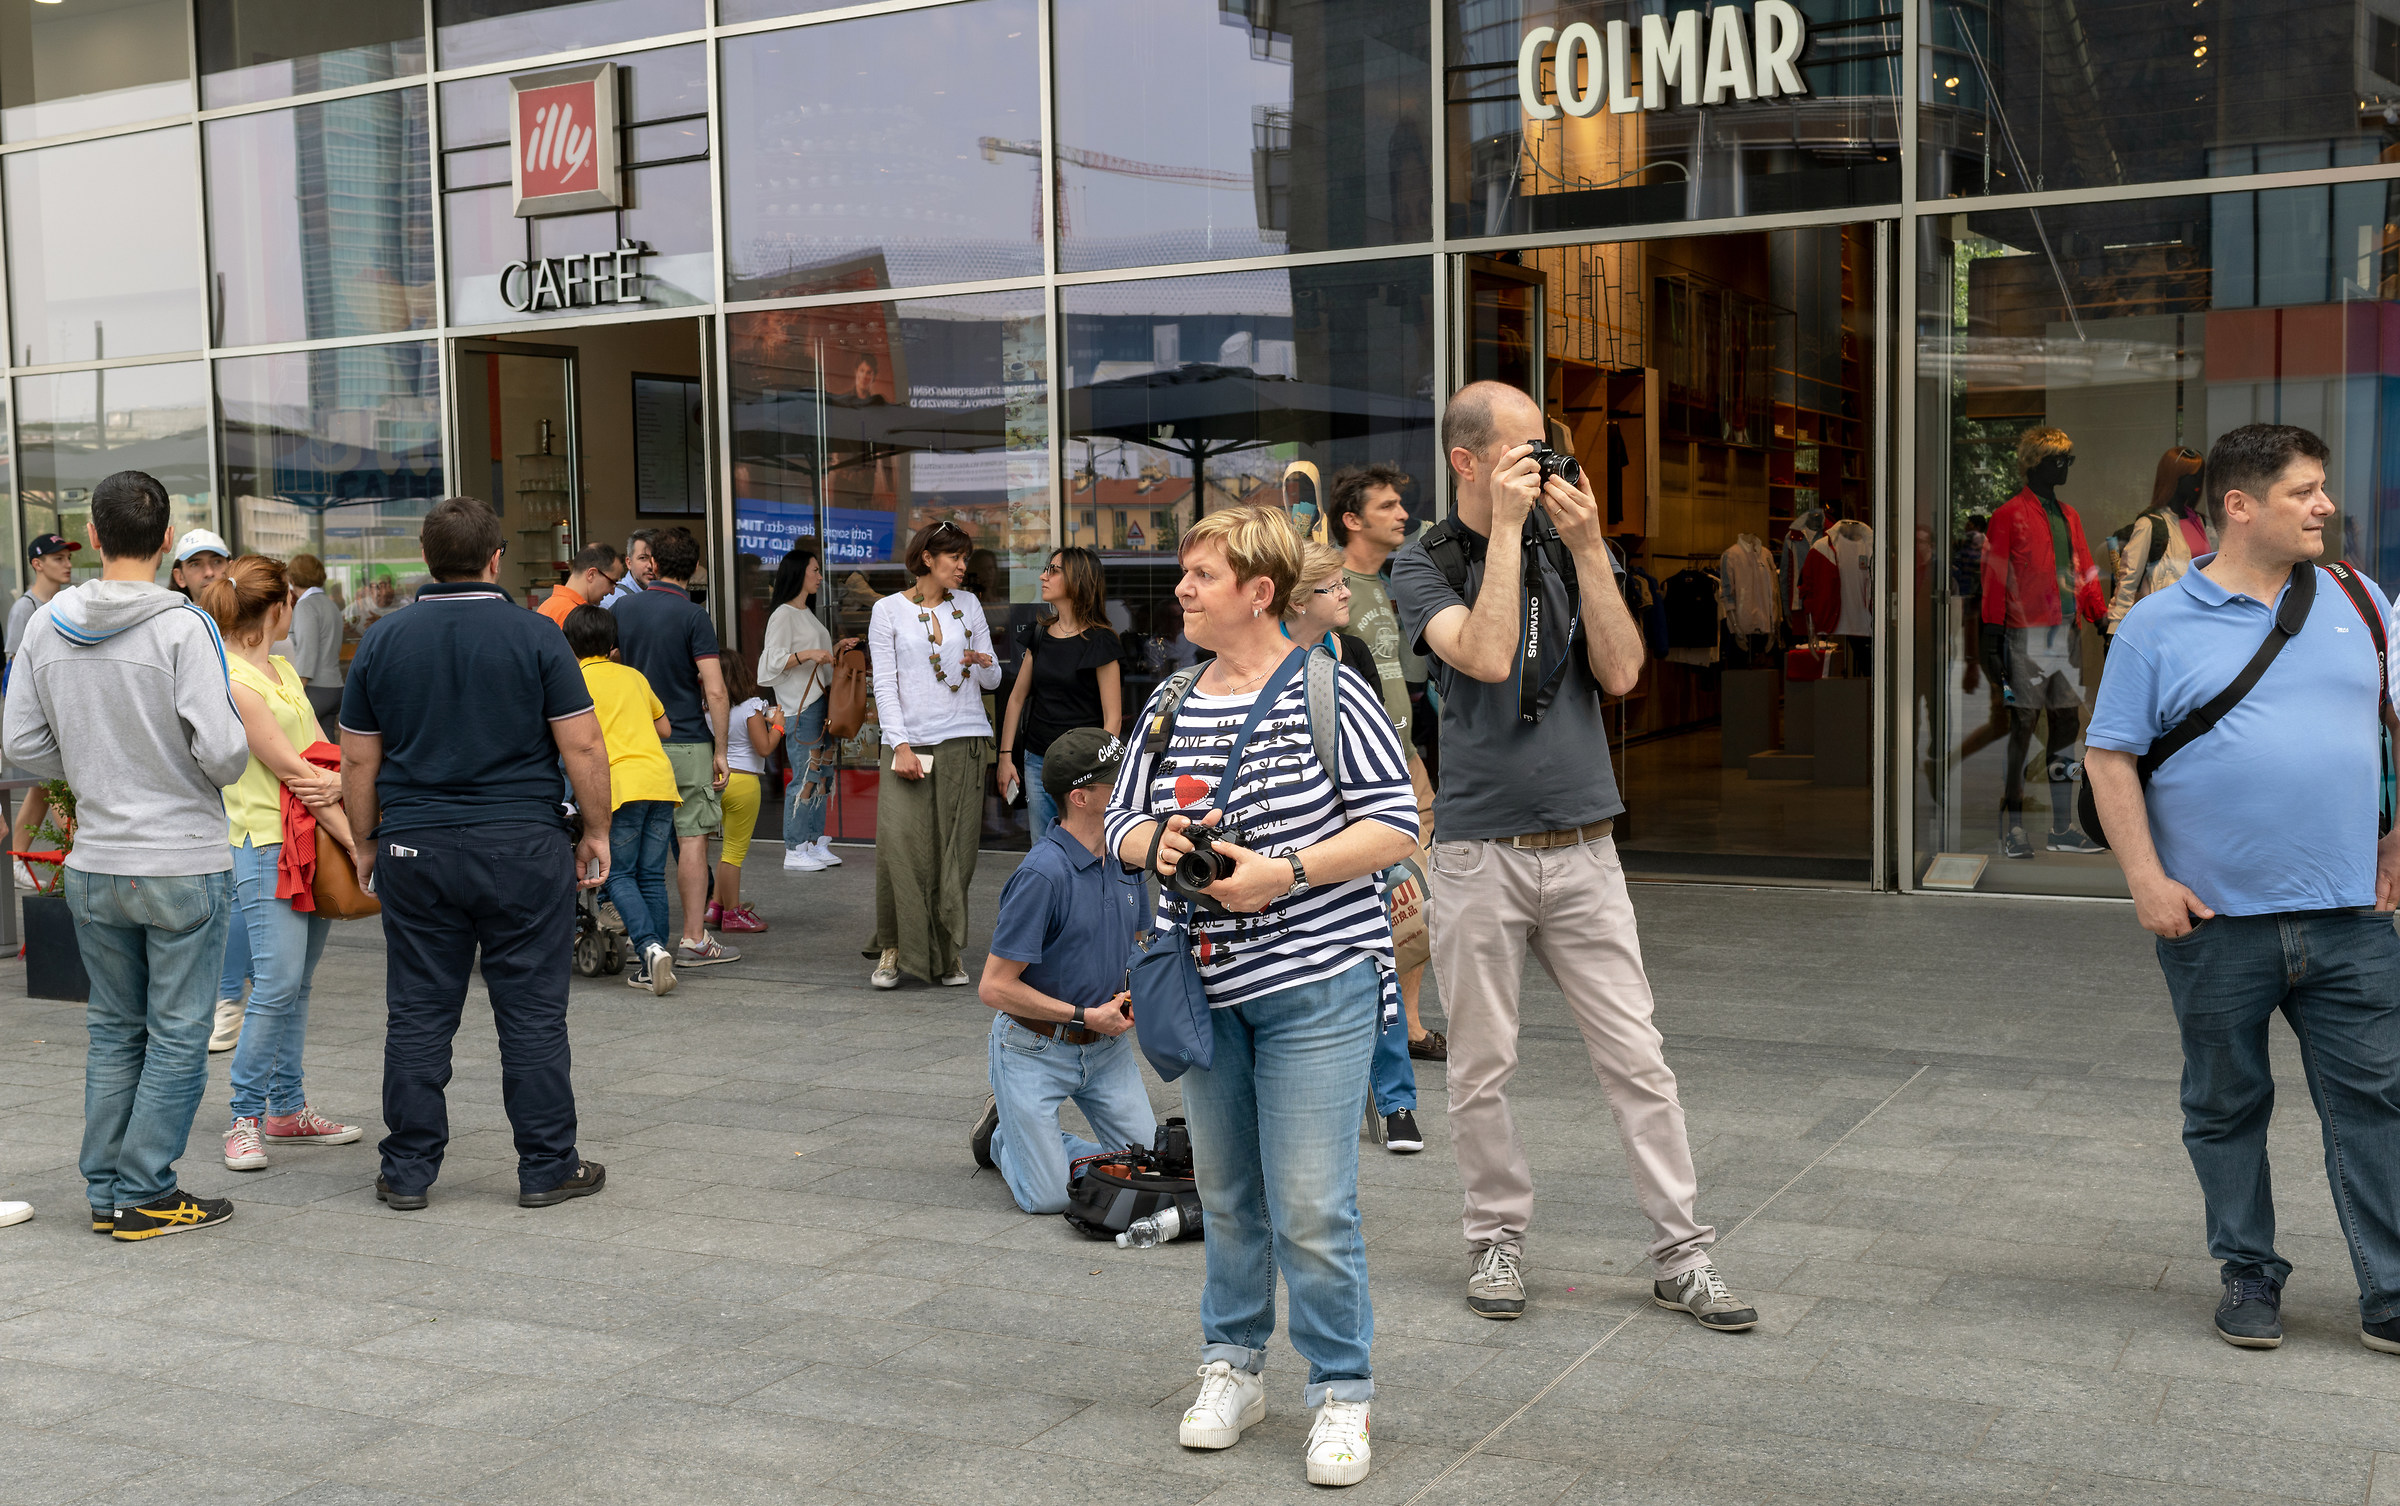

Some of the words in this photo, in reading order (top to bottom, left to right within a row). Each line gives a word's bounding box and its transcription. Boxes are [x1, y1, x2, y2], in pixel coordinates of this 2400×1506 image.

[1518, 0, 1807, 119] COLMAR
[526, 102, 593, 184] illy
[499, 238, 643, 312] CAFFÈ
[1528, 596, 1539, 658] OLYMPUS
[1210, 719, 1237, 759] LOVE
[1391, 905, 1418, 928] 印良品
